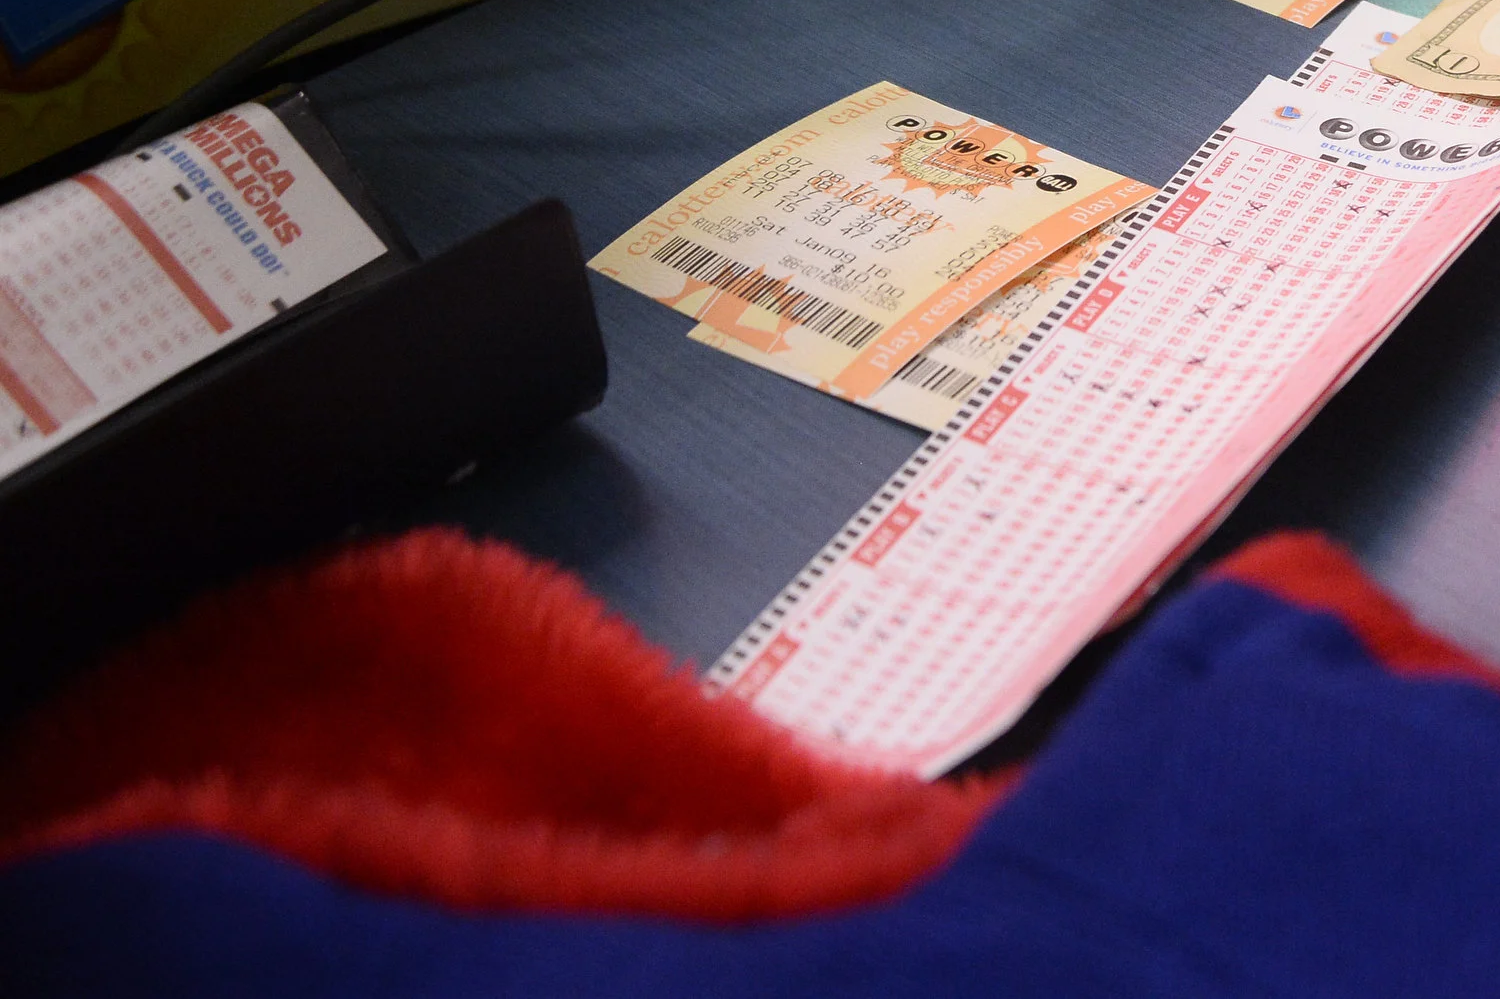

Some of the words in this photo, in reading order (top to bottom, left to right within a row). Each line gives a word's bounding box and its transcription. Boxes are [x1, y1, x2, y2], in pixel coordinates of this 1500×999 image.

[1406, 45, 1480, 75] 10
[183, 126, 302, 248] MILLIONS
[206, 113, 296, 198] MEGA
[774, 163, 799, 176] 04
[806, 176, 833, 190] 08
[843, 191, 866, 203] 16
[866, 154, 894, 168] PLAY
[893, 165, 926, 182] EVERY
[961, 192, 984, 204] SAT
[1212, 157, 1234, 179] SELECT
[1320, 143, 1373, 160] BELIEVE
[1395, 161, 1466, 171] SOMETHING
[170, 151, 215, 194] BUCK
[207, 190, 259, 246] COULD
[251, 242, 284, 274] DO!
[742, 186, 763, 197] 11
[774, 199, 798, 213] 15
[804, 211, 831, 226] 39
[837, 225, 863, 240] 47
[871, 239, 898, 254] 57
[751, 177, 777, 191] 25
[783, 190, 809, 205] 27
[816, 204, 840, 217] 31
[849, 218, 876, 232] 36
[883, 231, 911, 246] 40
[763, 170, 788, 184] 07
[798, 184, 821, 197] 17
[827, 196, 854, 210] 27
[861, 210, 887, 224] 37
[895, 224, 921, 238] 47
[786, 156, 812, 169] 07
[818, 169, 844, 183] 08
[854, 183, 877, 196] 17
[887, 196, 911, 209] 18
[918, 209, 942, 222] 21
[1069, 195, 1117, 224] play
[1164, 203, 1191, 229] PLAY
[1184, 193, 1200, 203] E
[751, 215, 787, 235] Sat
[795, 233, 856, 265] Jan09
[865, 263, 892, 278] 16
[868, 329, 919, 371] play
[919, 234, 1044, 325] responsibly
